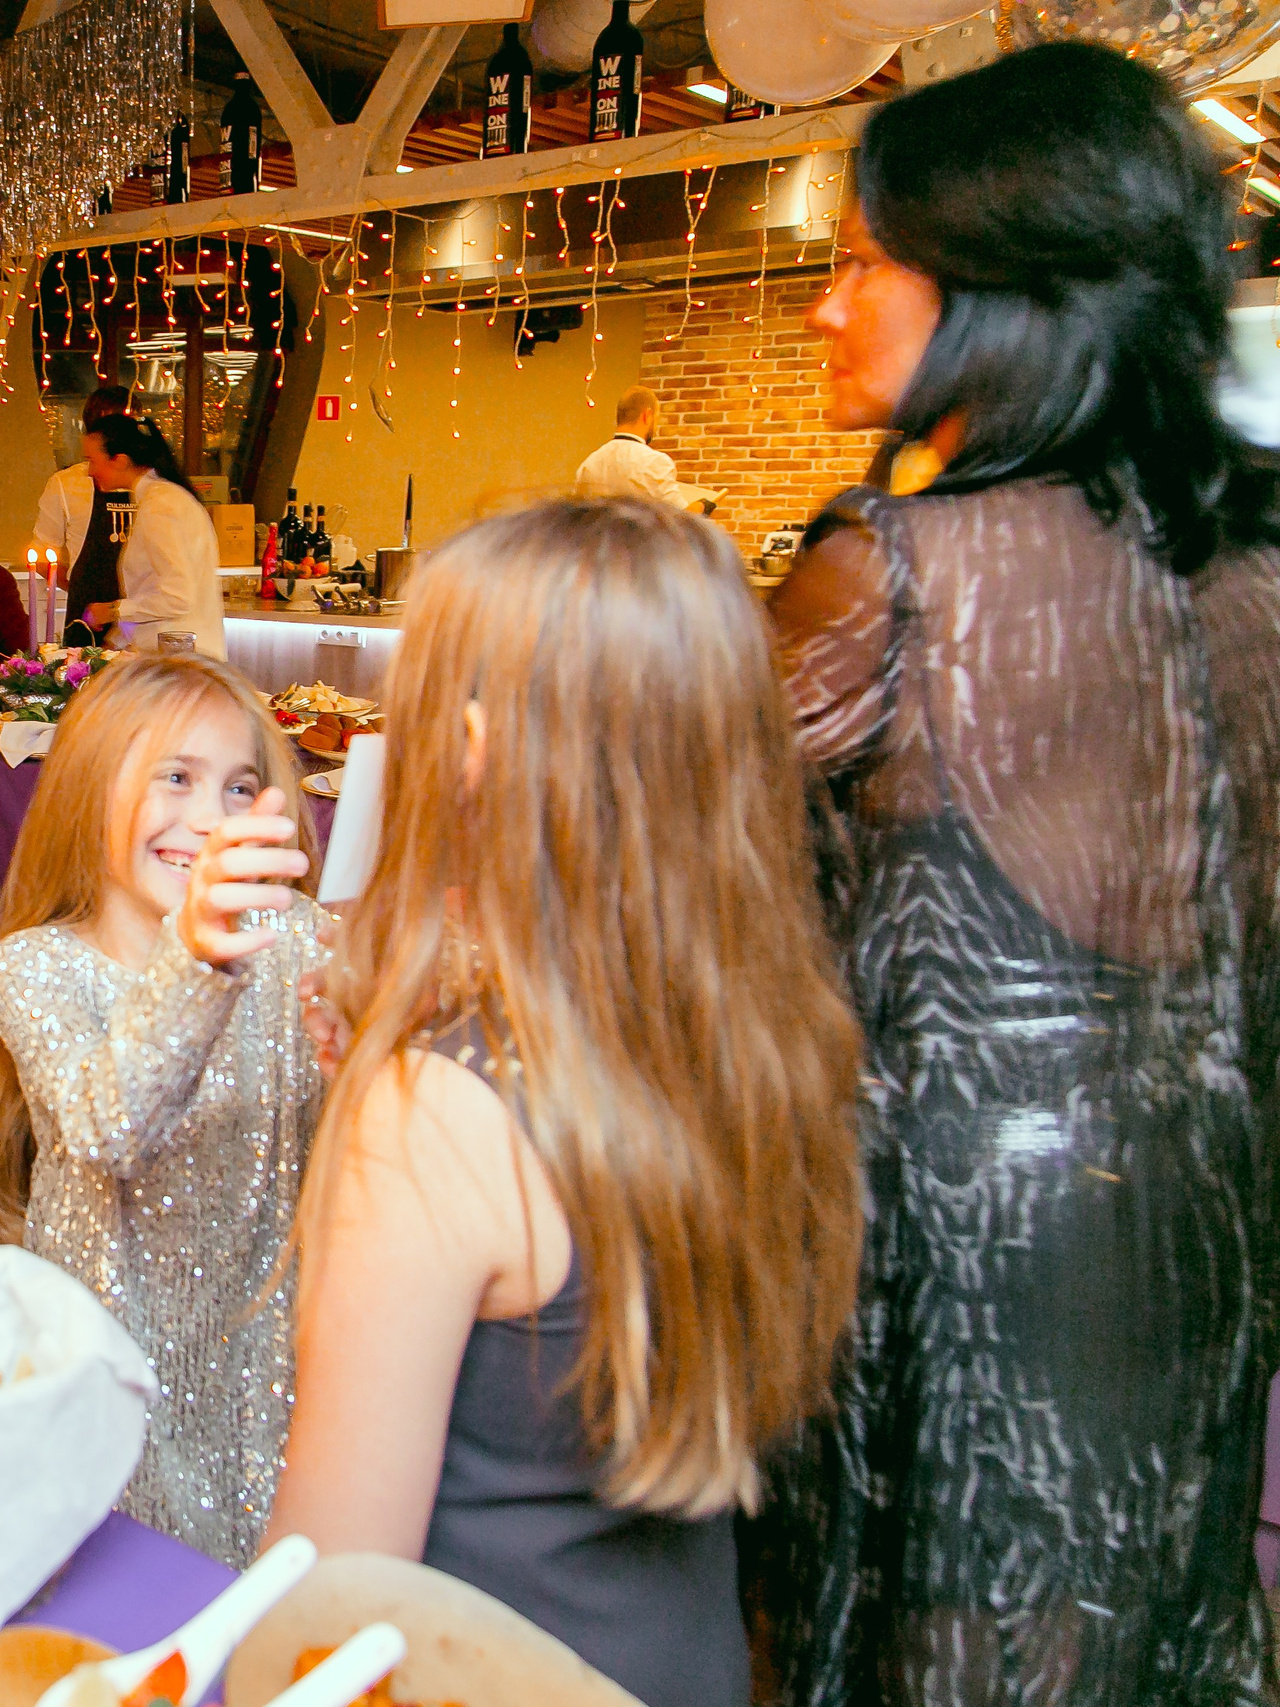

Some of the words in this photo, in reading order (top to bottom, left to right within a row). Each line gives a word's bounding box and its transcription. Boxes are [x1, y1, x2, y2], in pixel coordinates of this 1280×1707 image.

[600, 56, 621, 76] W
[490, 74, 509, 94] W
[598, 76, 620, 90] INE
[488, 94, 508, 107] INE
[597, 97, 617, 110] ON
[487, 113, 506, 126] ON
